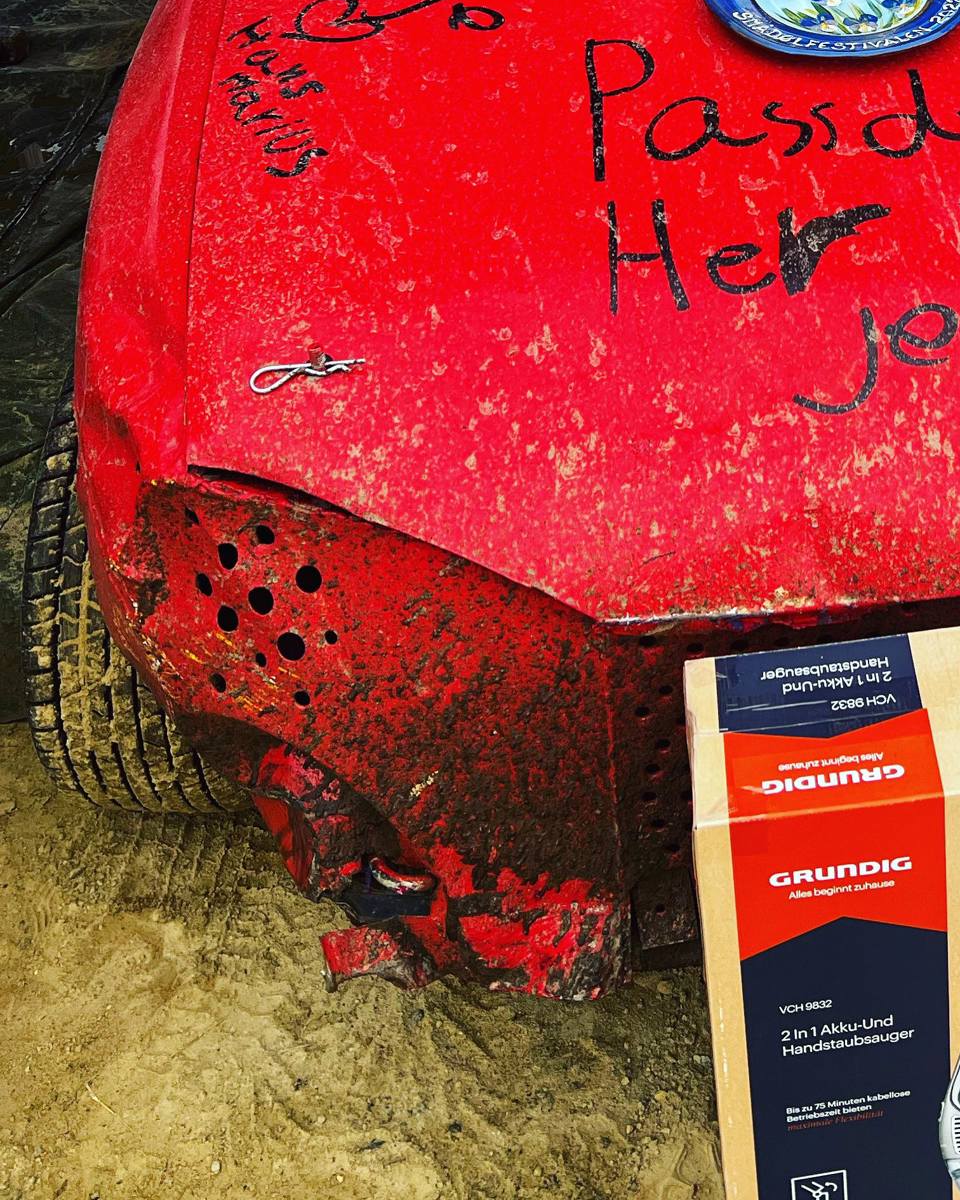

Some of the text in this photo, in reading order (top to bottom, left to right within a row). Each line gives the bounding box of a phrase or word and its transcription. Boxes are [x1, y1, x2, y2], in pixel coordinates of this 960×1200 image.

[733, 10, 932, 51] SMÅDØLFESTIVALEN
[226, 15, 326, 99] Hans
[607, 199, 891, 316] Her
[761, 656, 889, 681] Handstaubsauger
[783, 671, 892, 695] 2 In 1 Akku-Und
[831, 693, 896, 711] VCH 9832
[778, 752, 884, 771] Alles beginnt zuhause
[761, 764, 905, 795] GRUNDIG
[769, 856, 912, 887] GRUNDIG
[788, 879, 895, 900] Alles beginnt zuhause
[779, 999, 832, 1014] VCH 9832
[781, 1014, 894, 1042] 2 In 1 Akku-Und
[782, 1028, 915, 1057] Handstaubsauger
[786, 1089, 911, 1115] Bis zu 75 Minuten kabellose
[787, 1104, 872, 1123] Betriebszeit bieten
